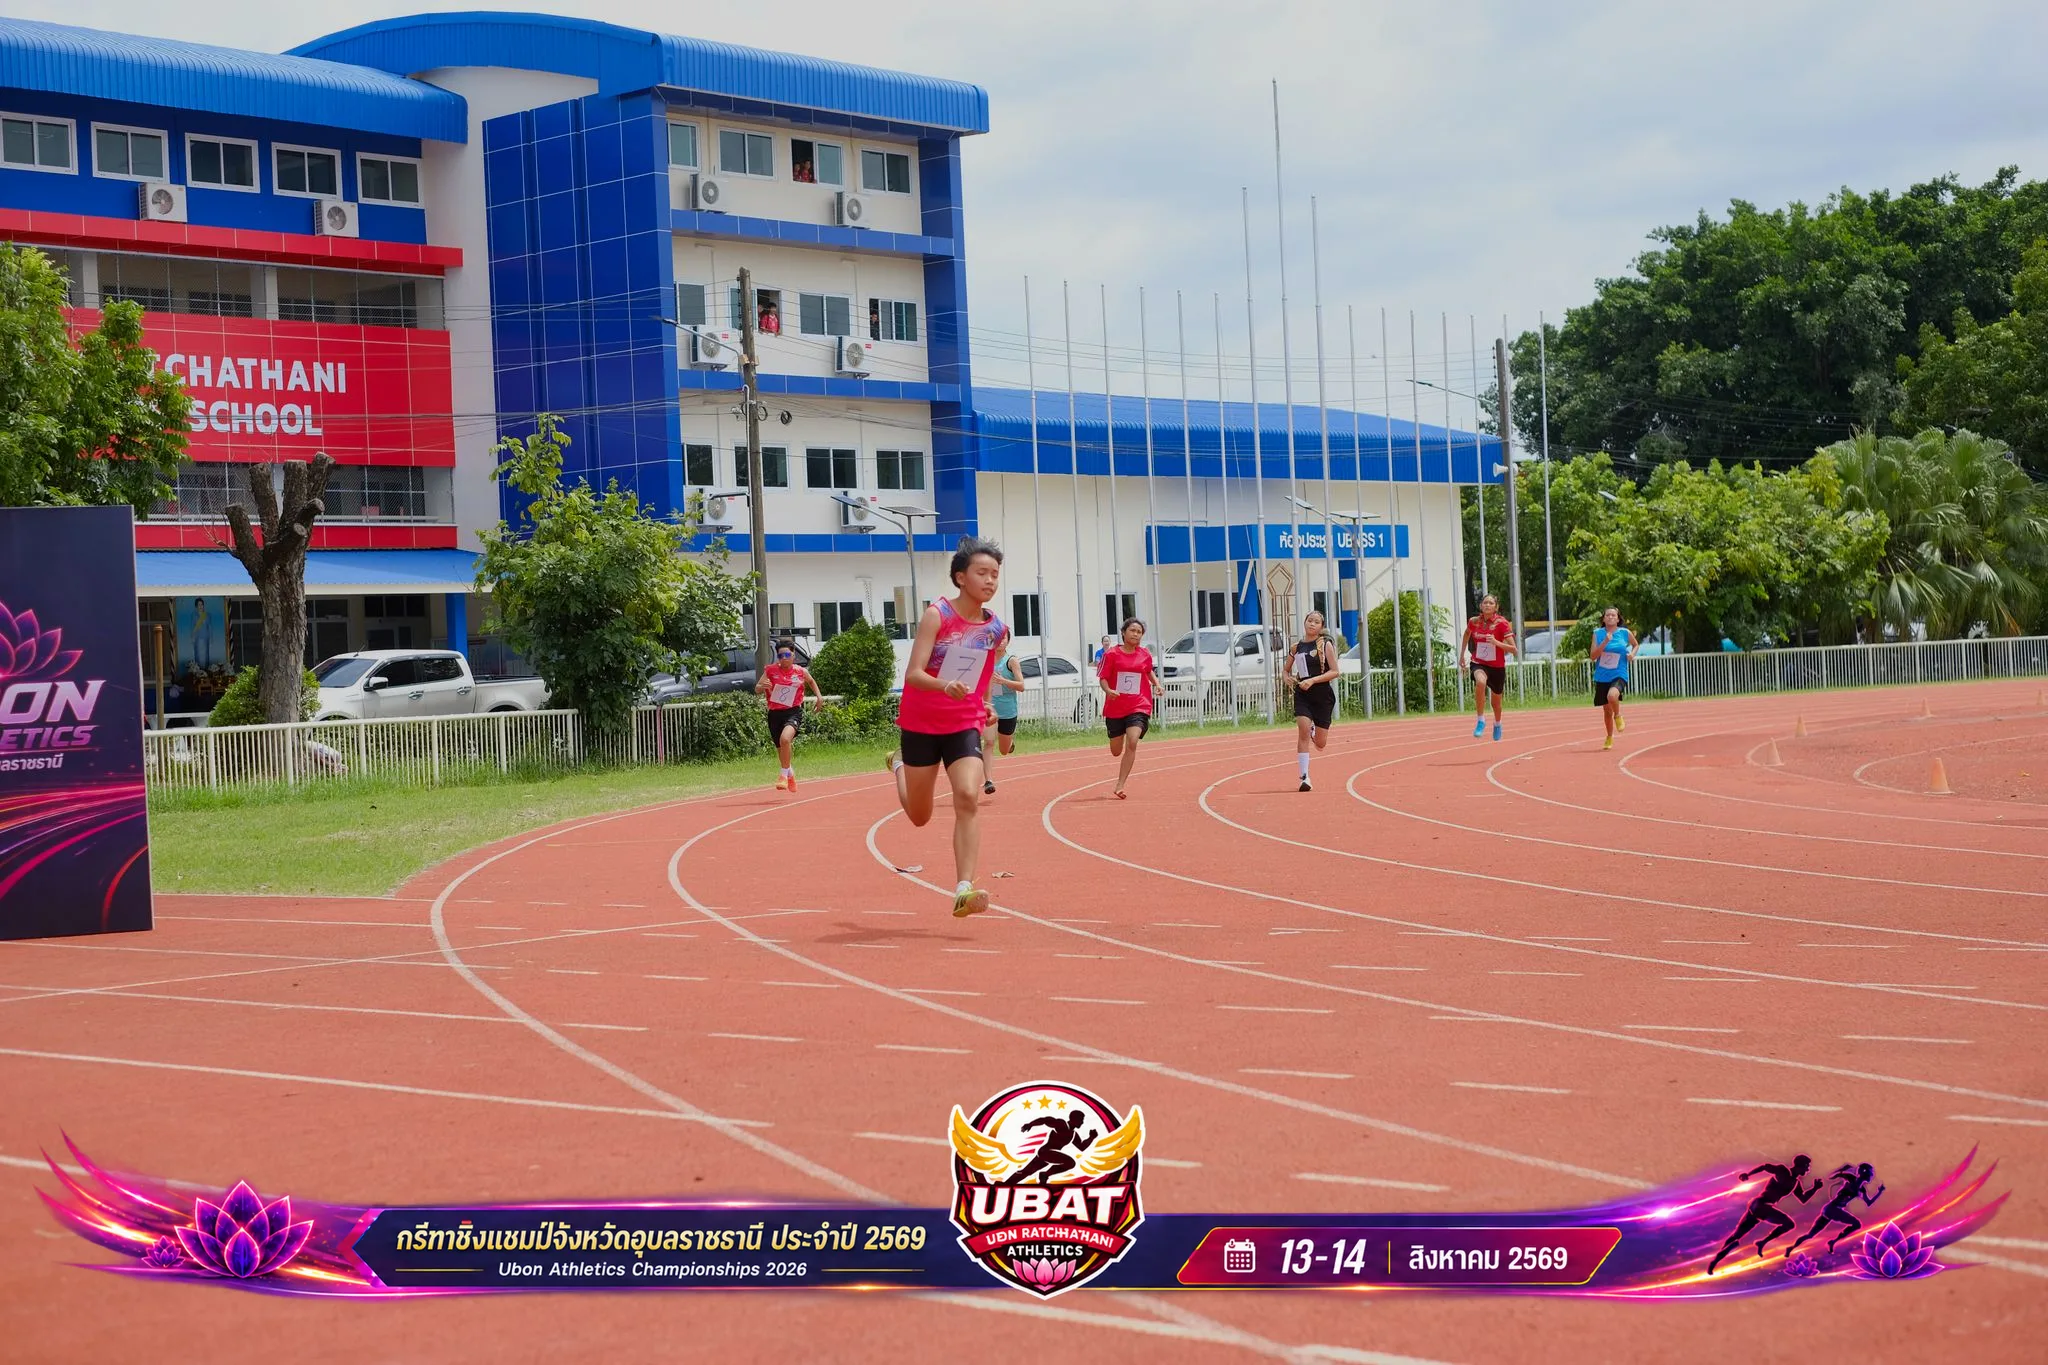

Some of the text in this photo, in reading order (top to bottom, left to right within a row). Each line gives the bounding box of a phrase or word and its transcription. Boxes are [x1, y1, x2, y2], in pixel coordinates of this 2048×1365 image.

[189, 400, 323, 436] SCHOOL
[1378, 532, 1385, 548] 1
[957, 656, 977, 681] 7
[1123, 675, 1135, 691] 5
[779, 687, 791, 702] 8
